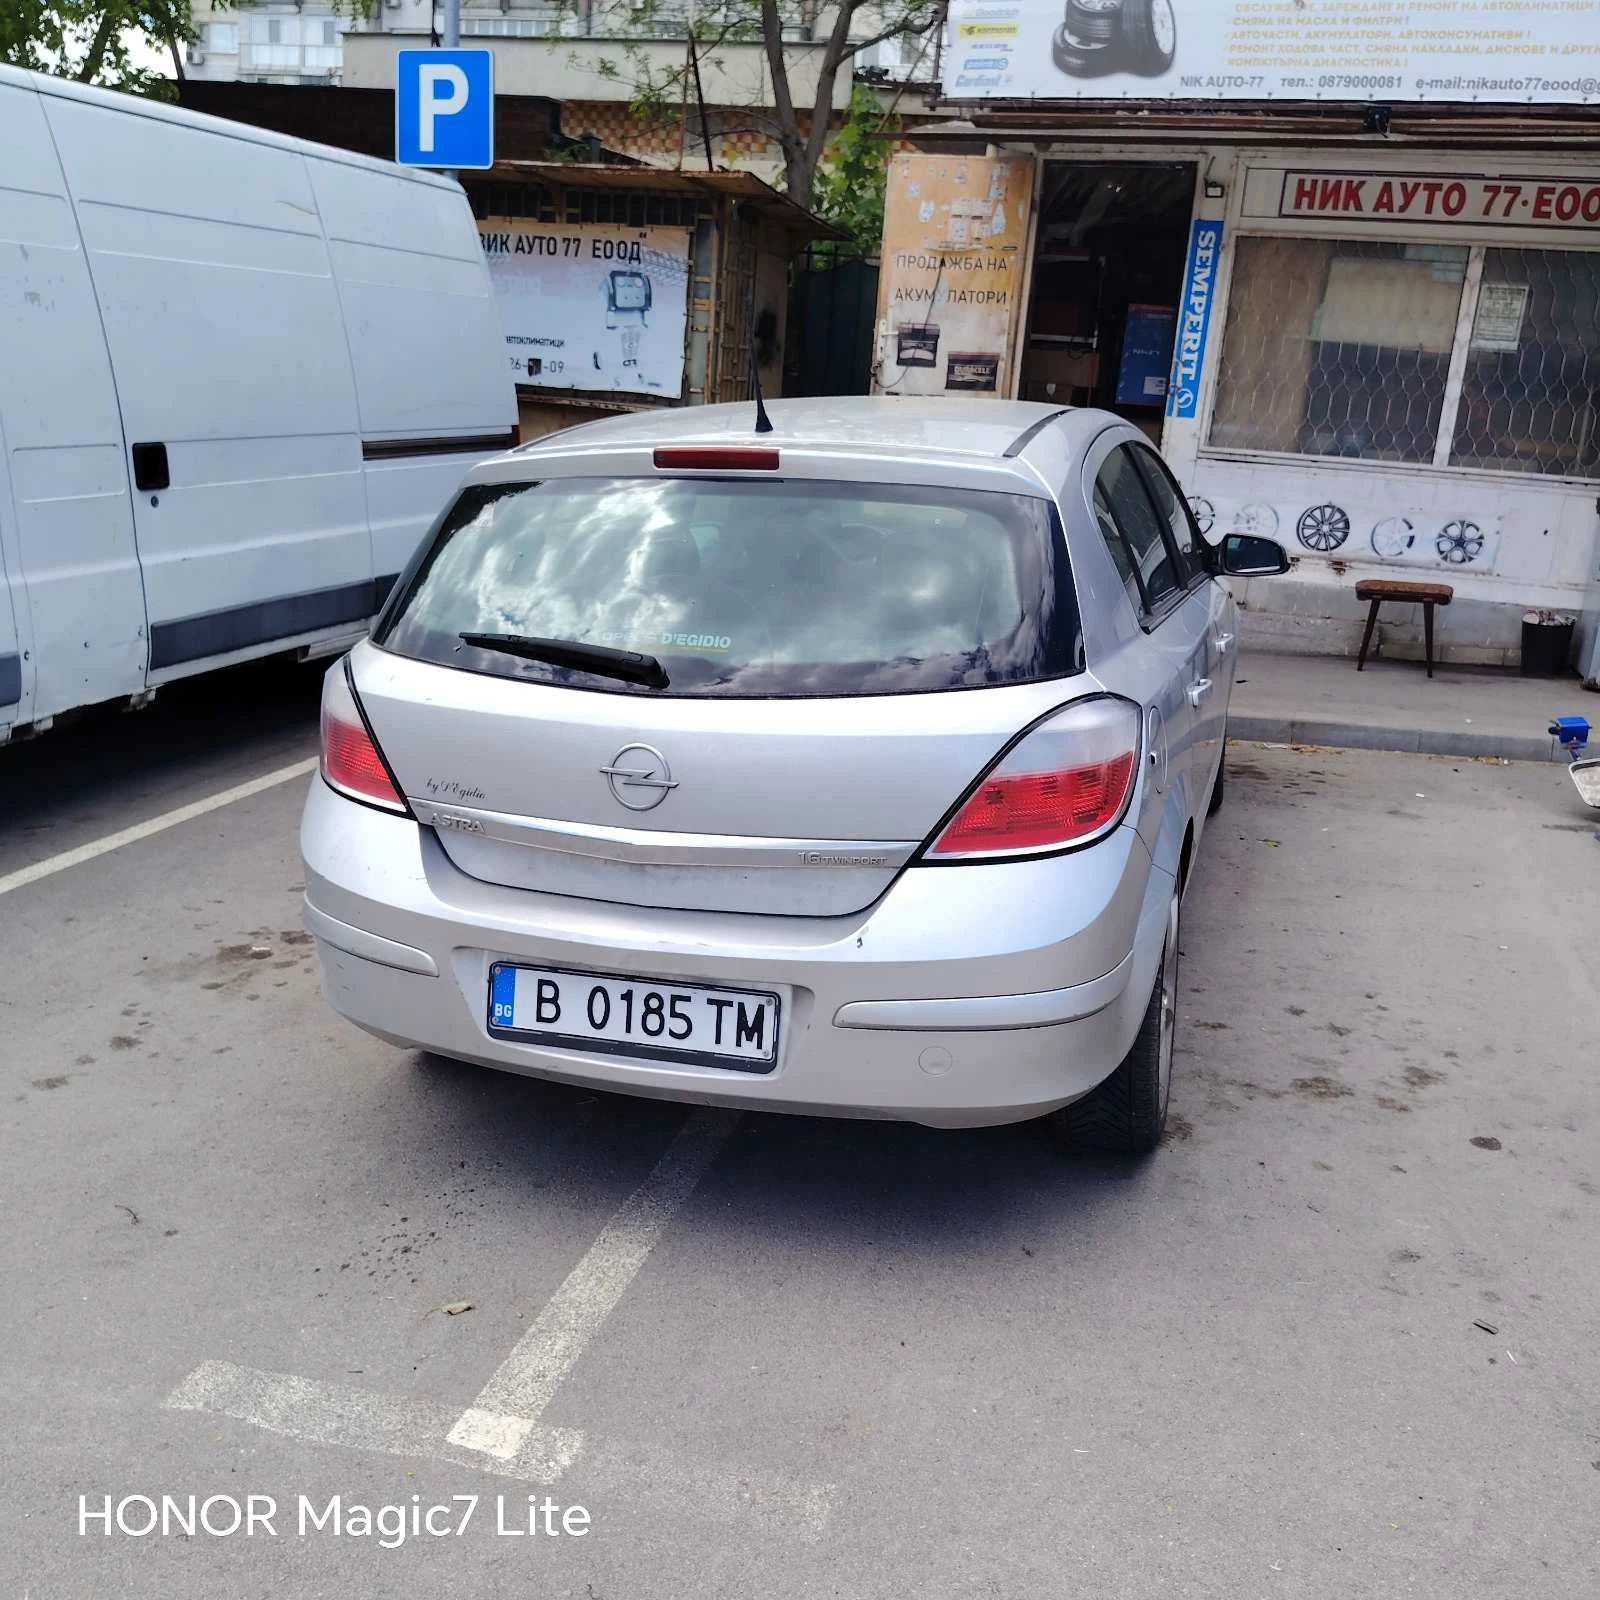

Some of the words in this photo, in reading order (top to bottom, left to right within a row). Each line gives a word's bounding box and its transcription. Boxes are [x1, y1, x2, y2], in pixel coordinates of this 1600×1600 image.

[1180, 76, 1203, 88] NIK
[1206, 75, 1264, 89] AUTO-77
[1318, 75, 1402, 89] 0879000081
[1415, 76, 1600, 94] e-mail:nikauto77eood@
[419, 63, 469, 152] P
[1293, 177, 1367, 212] НИК
[1372, 181, 1467, 217] АУТО
[514, 234, 558, 256] АУТО
[561, 236, 583, 258] 77
[986, 256, 1008, 271] НА
[1181, 230, 1217, 381] SEMPERIT
[662, 632, 732, 649] D'EGIDIO
[430, 812, 487, 833] ASTRA
[494, 1003, 512, 1018] BG
[535, 978, 562, 1023] B
[586, 985, 693, 1040] 0185
[706, 998, 765, 1050] TM
